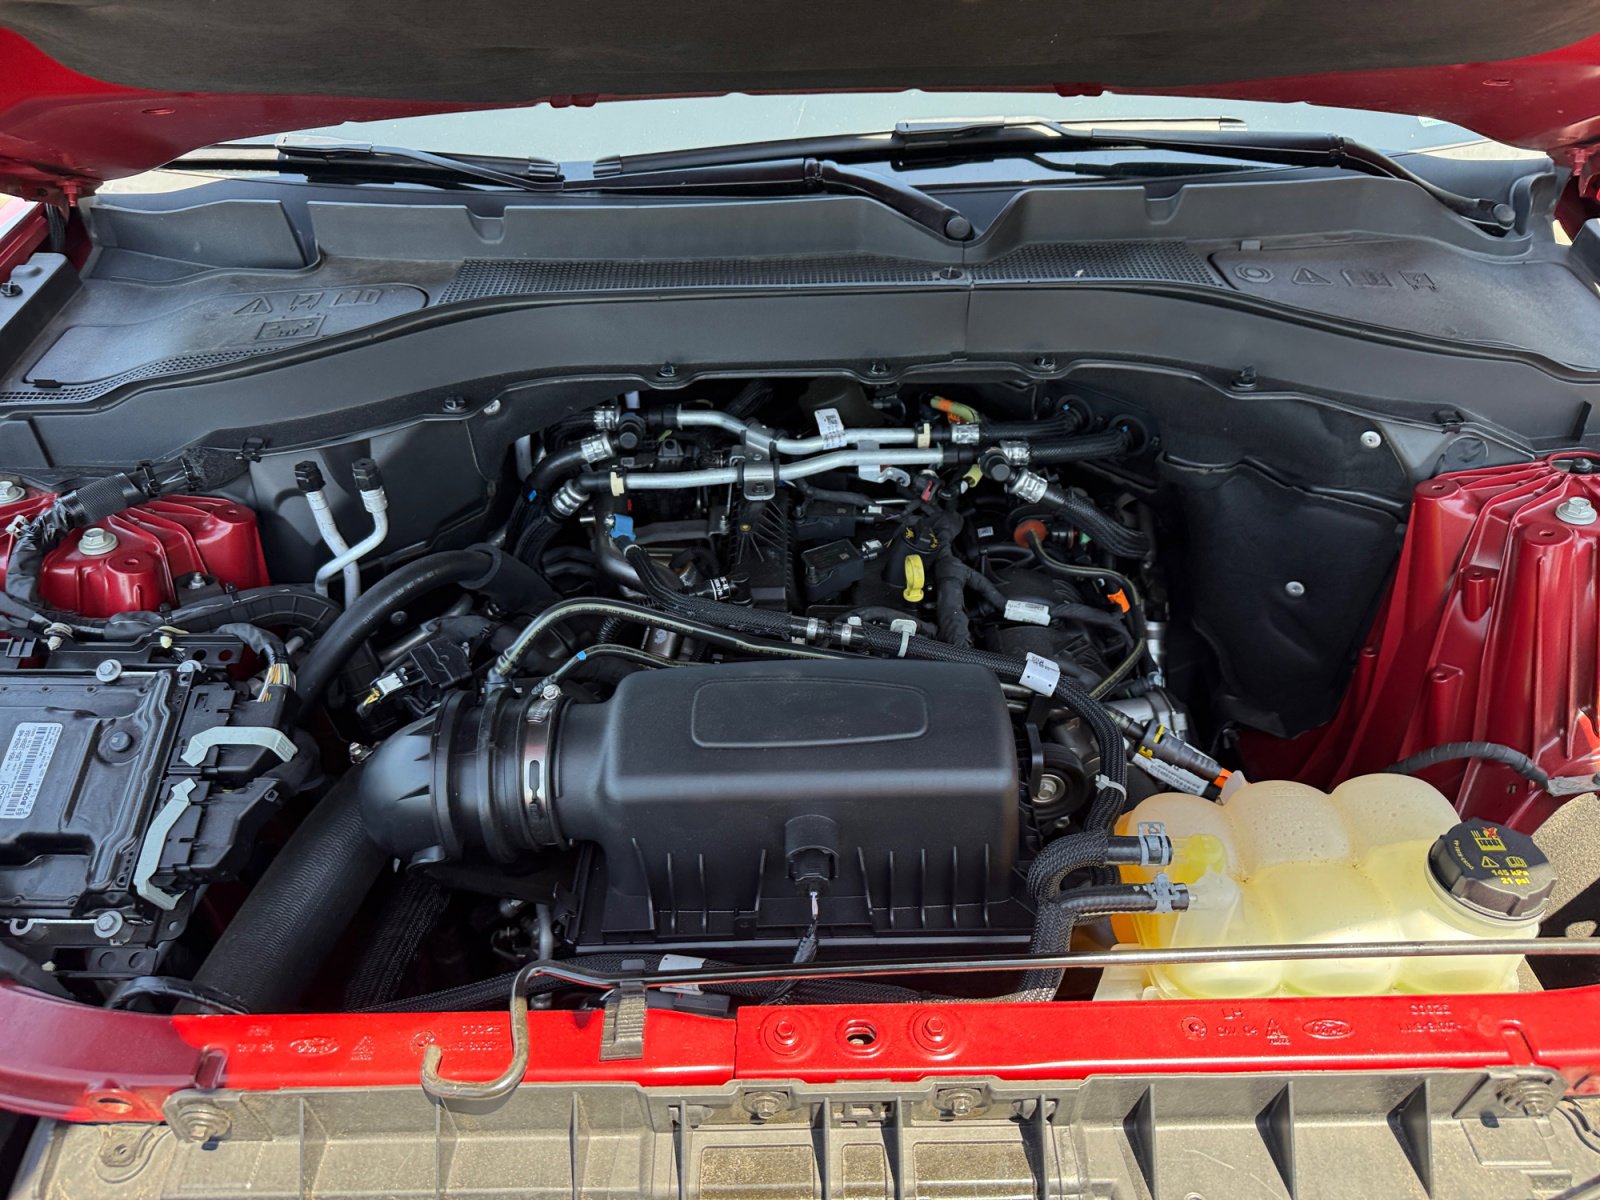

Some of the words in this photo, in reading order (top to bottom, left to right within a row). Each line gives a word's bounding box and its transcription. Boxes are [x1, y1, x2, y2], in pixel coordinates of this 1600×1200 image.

[19, 783, 34, 806] BOSCH
[1500, 877, 1514, 885] 21
[1515, 877, 1531, 886] psi
[1221, 1007, 1245, 1020] LH
[1306, 1020, 1352, 1038] Ford
